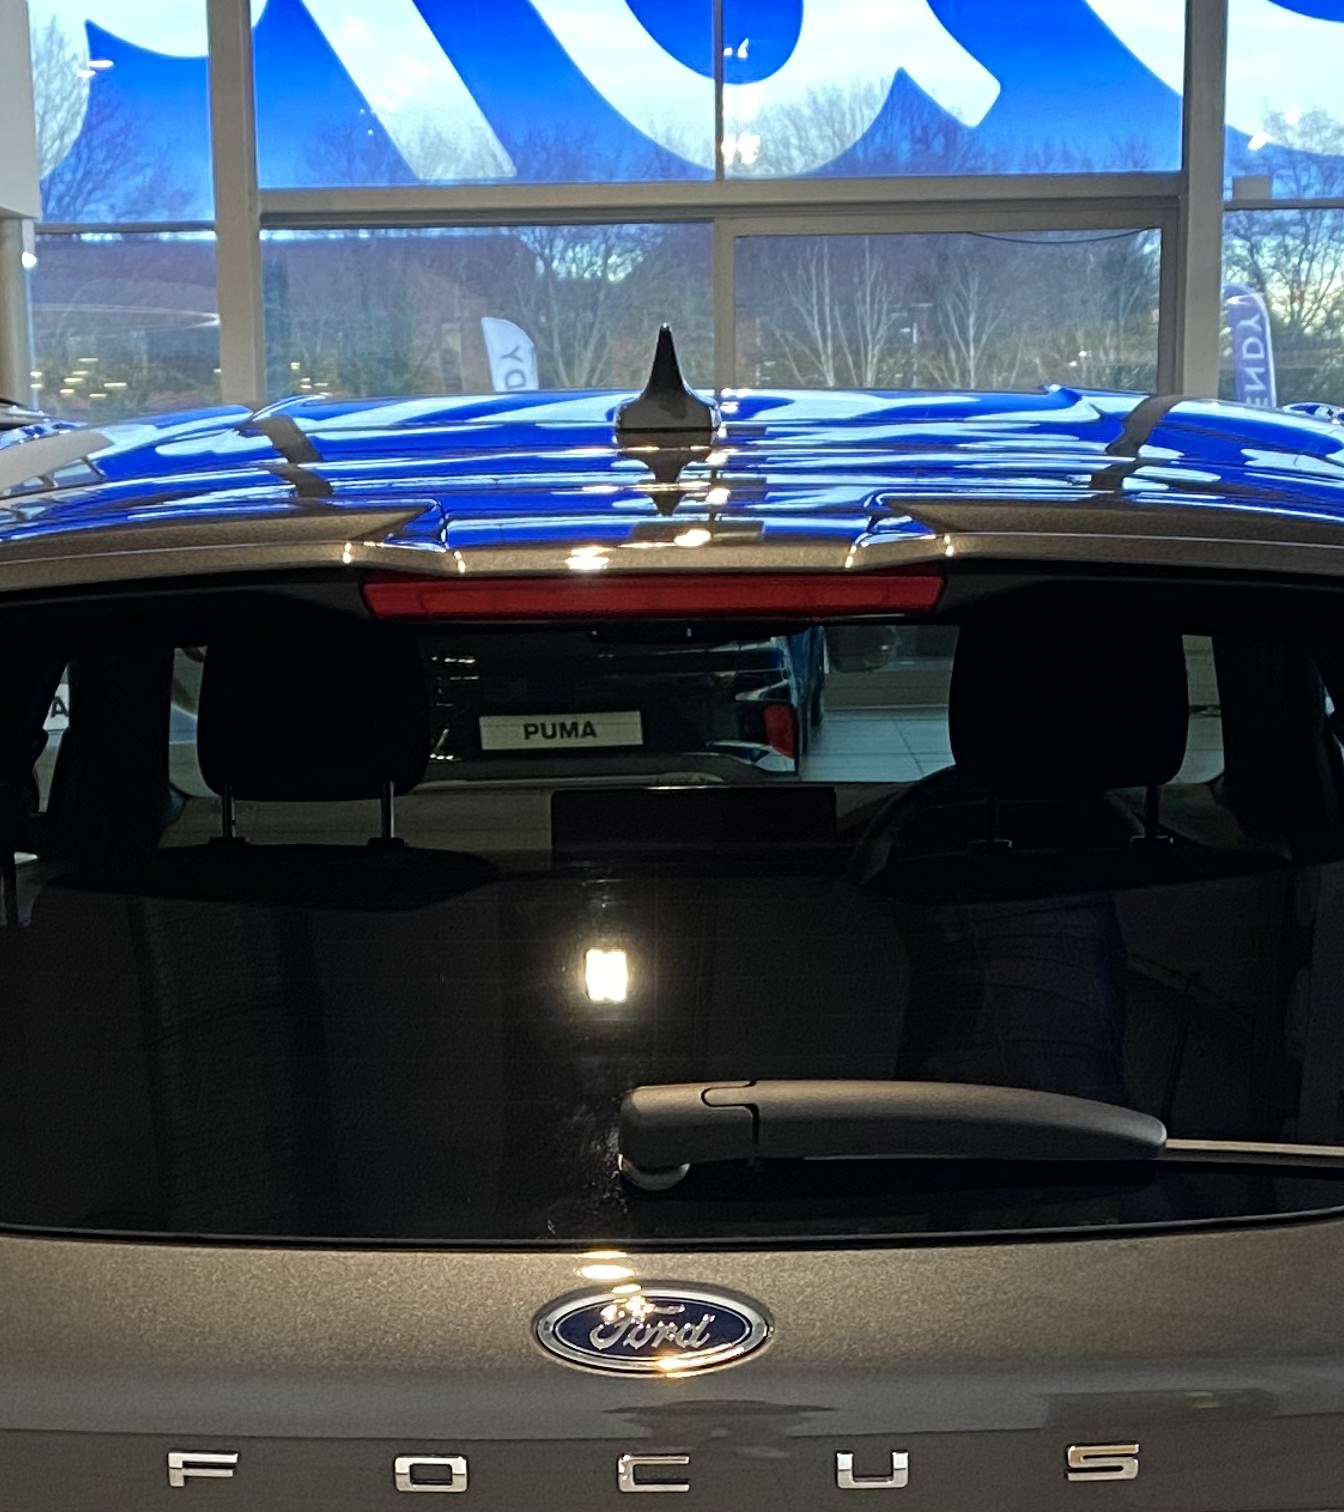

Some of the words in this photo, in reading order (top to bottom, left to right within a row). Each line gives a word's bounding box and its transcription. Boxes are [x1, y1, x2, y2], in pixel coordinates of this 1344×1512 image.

[523, 721, 598, 740] PUMA
[588, 1298, 716, 1350] Ford
[167, 1443, 1140, 1493] FOCUS
